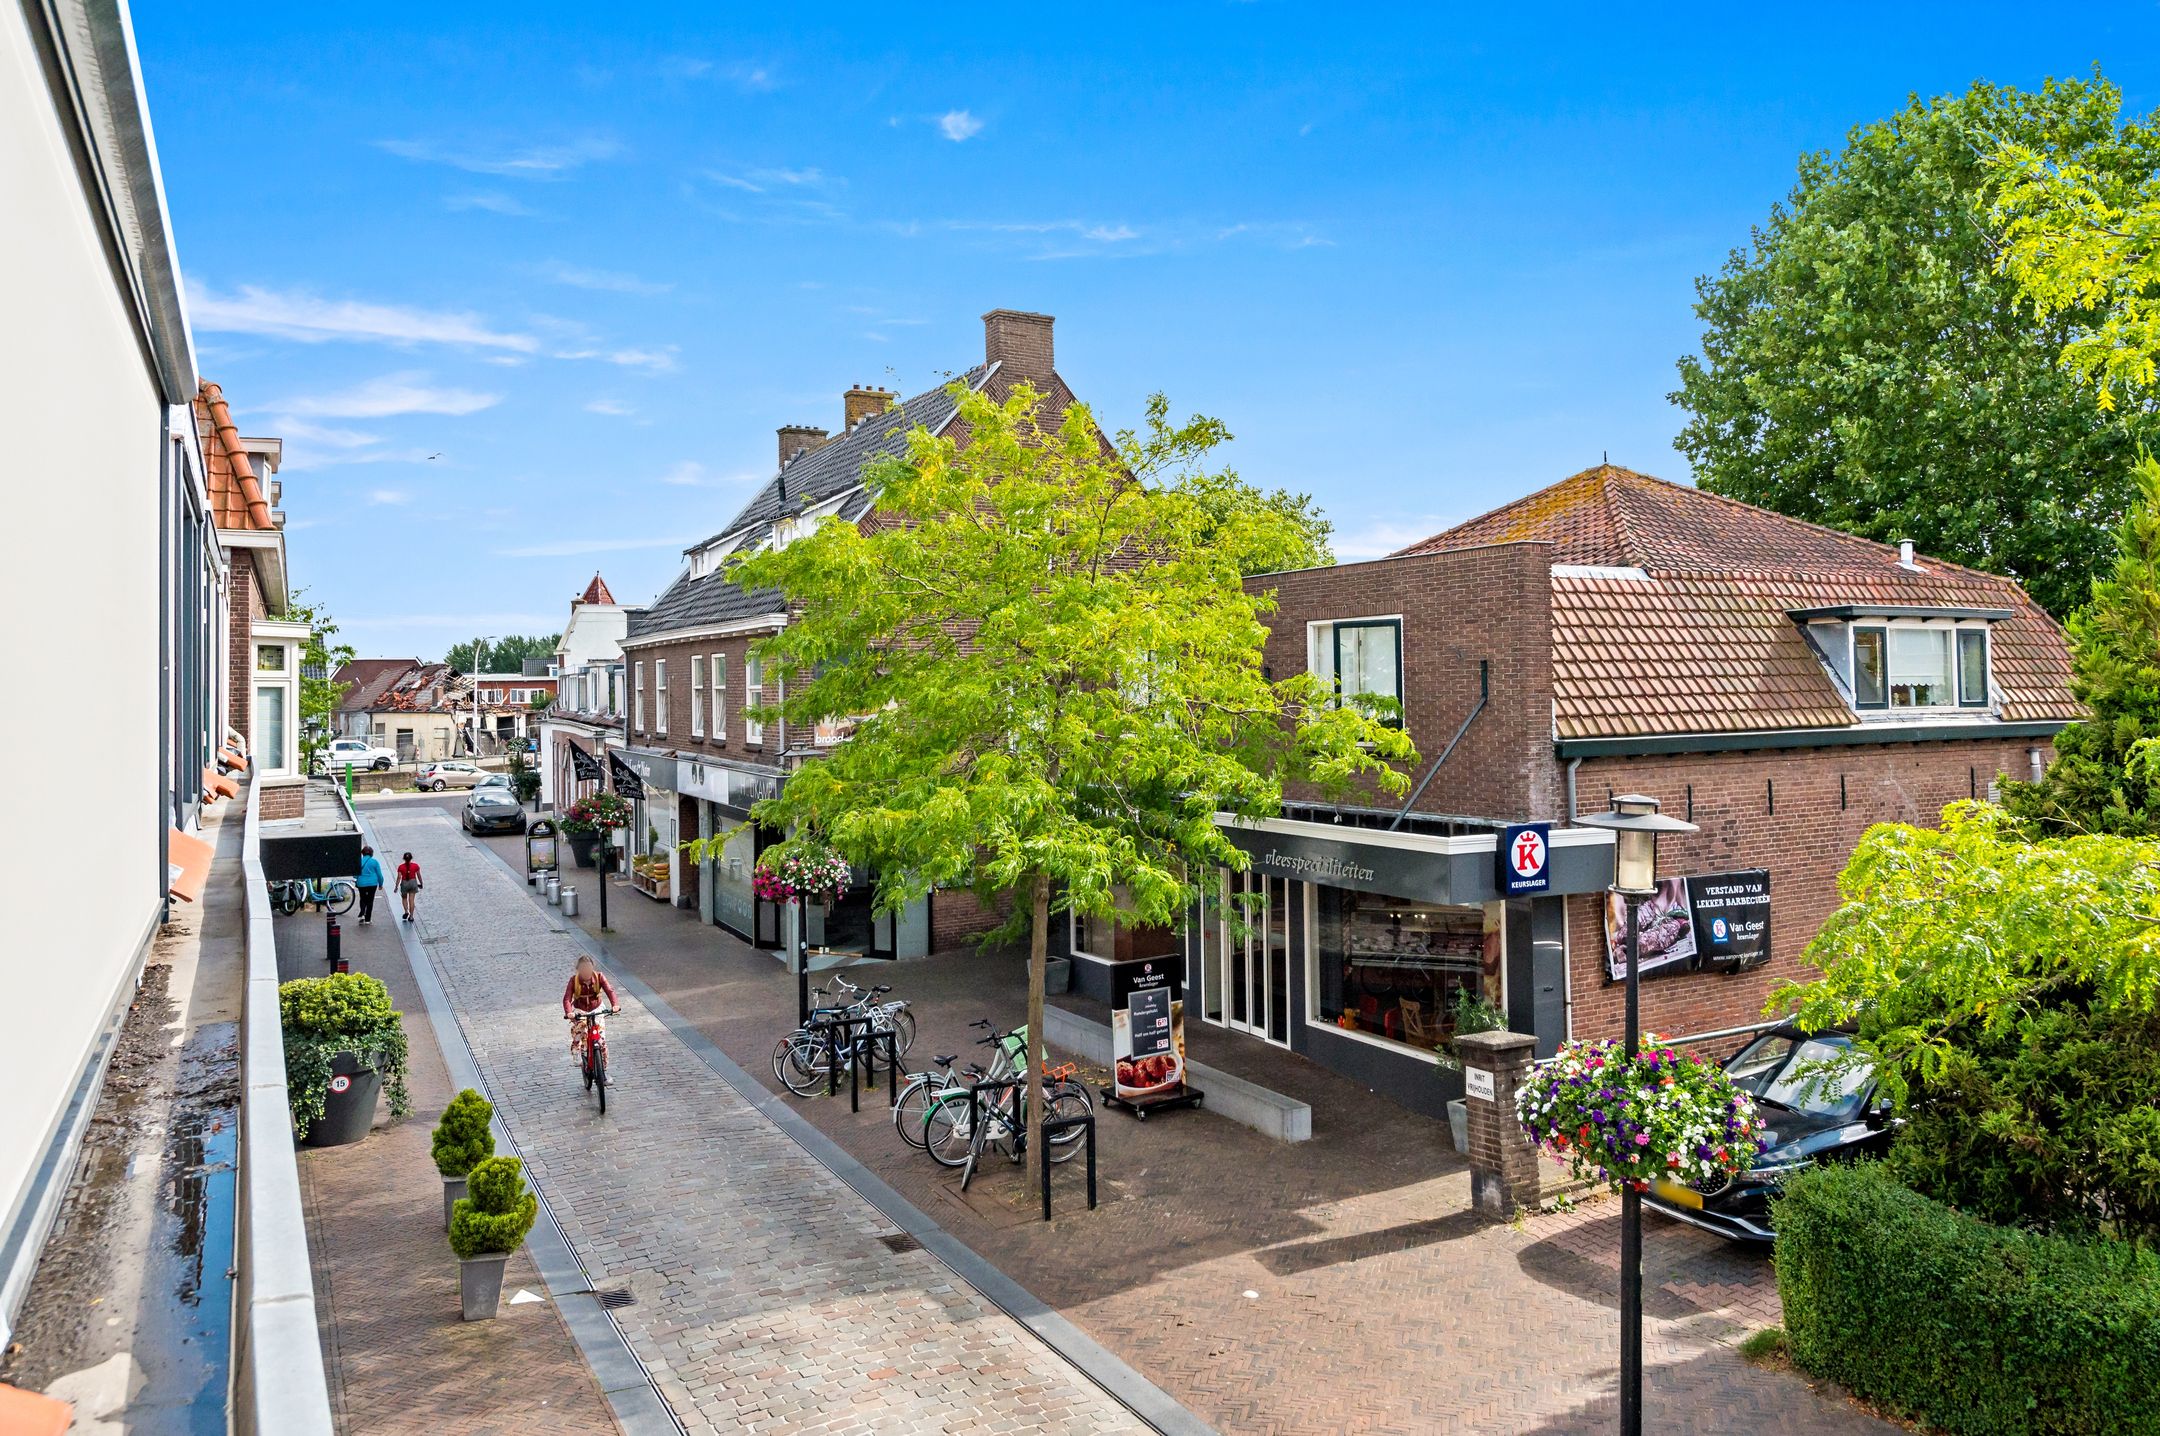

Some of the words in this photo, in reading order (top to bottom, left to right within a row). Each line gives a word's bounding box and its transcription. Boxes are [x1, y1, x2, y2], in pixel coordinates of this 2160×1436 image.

[1517, 843, 1540, 870] K
[1265, 848, 1374, 881] vleesspecialiteiten
[1511, 879, 1546, 889] KEURSLAGER
[1706, 886, 1744, 895] VERSTAND
[1746, 884, 1762, 893] VAN
[1696, 899, 1724, 908] LEKKER
[1729, 922, 1744, 932] Van
[1745, 921, 1764, 931] Geest
[1736, 932, 1760, 940] keurslager
[1133, 976, 1146, 984] Van
[1146, 973, 1165, 982] Geest
[1474, 1073, 1485, 1082] INRIT
[336, 1080, 346, 1088] 15
